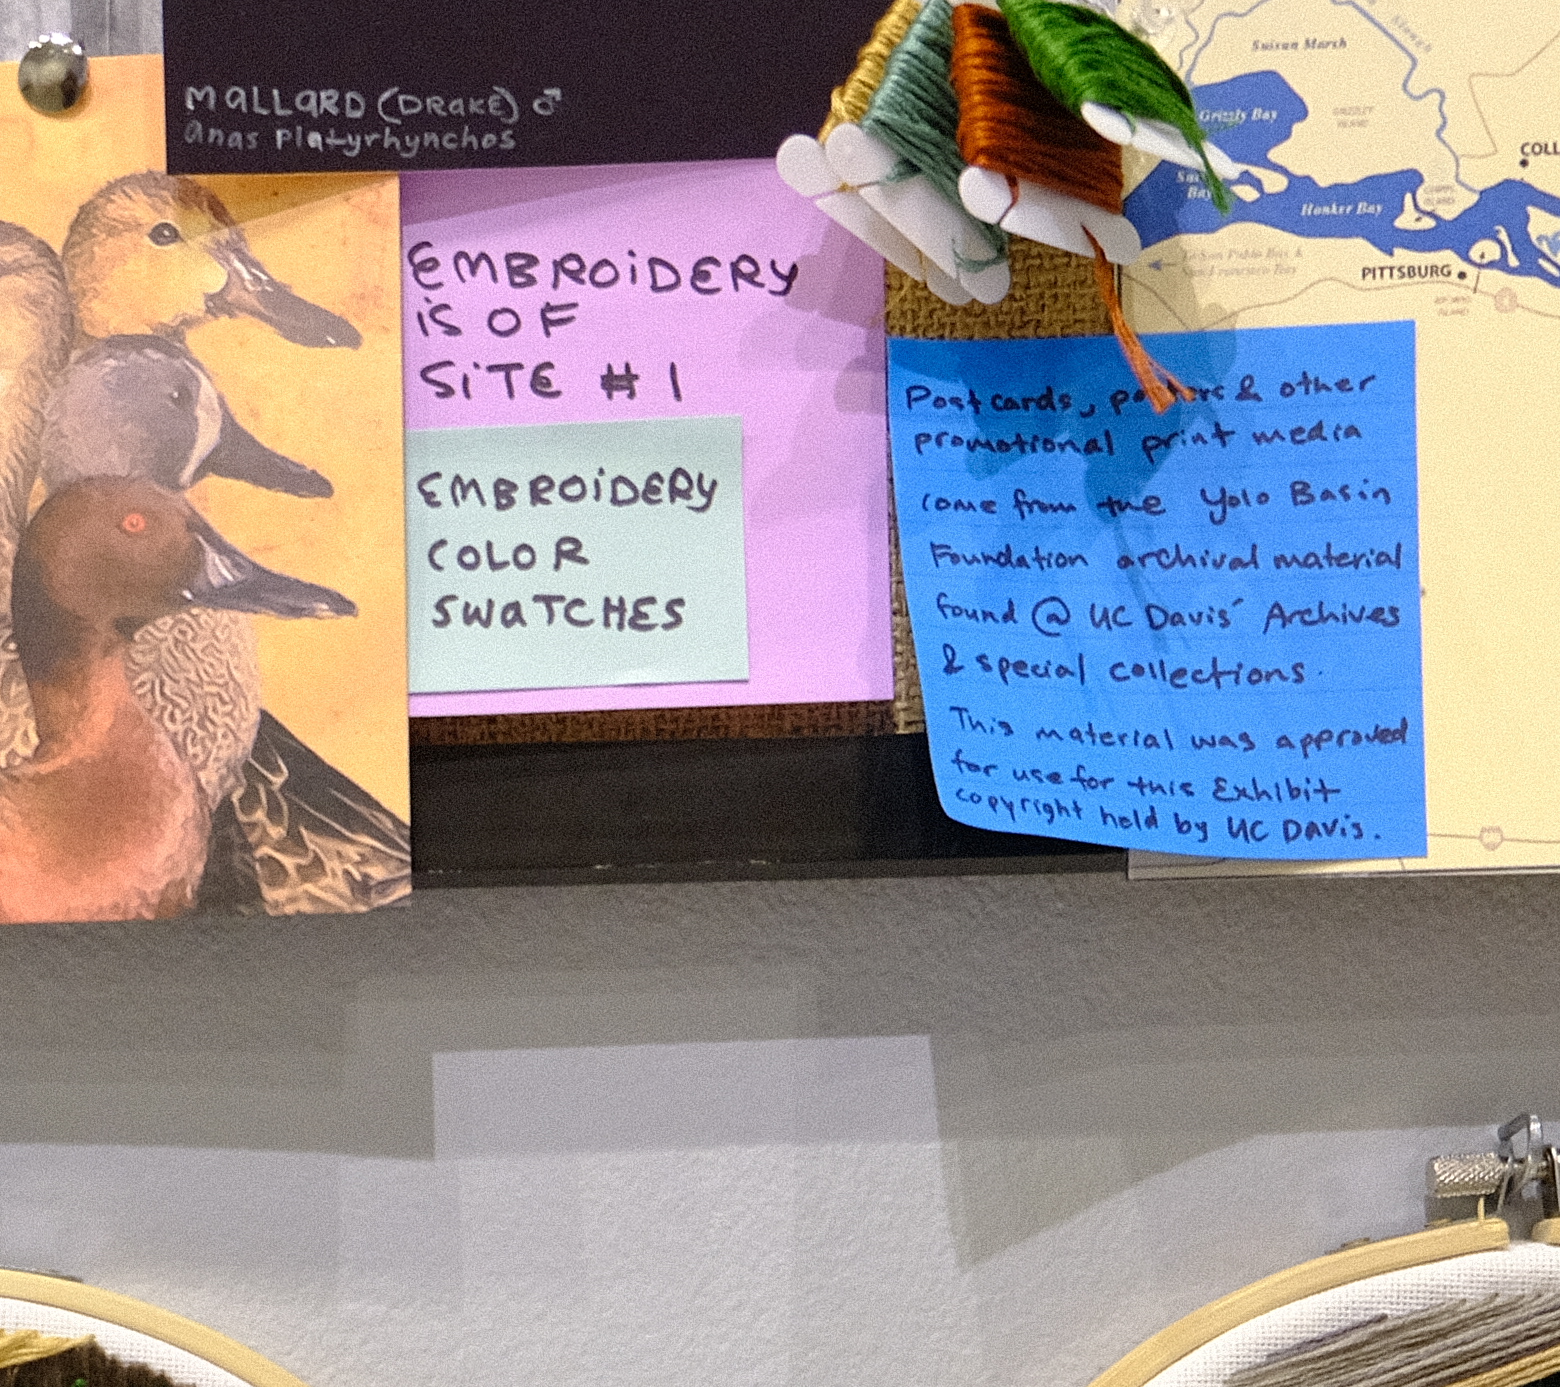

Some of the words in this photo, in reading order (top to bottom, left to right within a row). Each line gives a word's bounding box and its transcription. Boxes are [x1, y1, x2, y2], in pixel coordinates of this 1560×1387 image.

[184, 86, 366, 118] MALLARD
[379, 86, 521, 122] (DRAKE)
[1351, 201, 1383, 216] Bay
[408, 242, 799, 297] EMBROIDERY
[1360, 265, 1452, 280] PITTSBURG
[486, 302, 578, 338] OF
[421, 362, 562, 400] SITE
[418, 468, 718, 511] EMBROIDERY
[428, 538, 589, 572] COLOR
[930, 542, 1088, 569] Foundation
[1117, 545, 1260, 571] archival
[1275, 543, 1401, 569] material
[432, 597, 685, 631] SWATCHES
